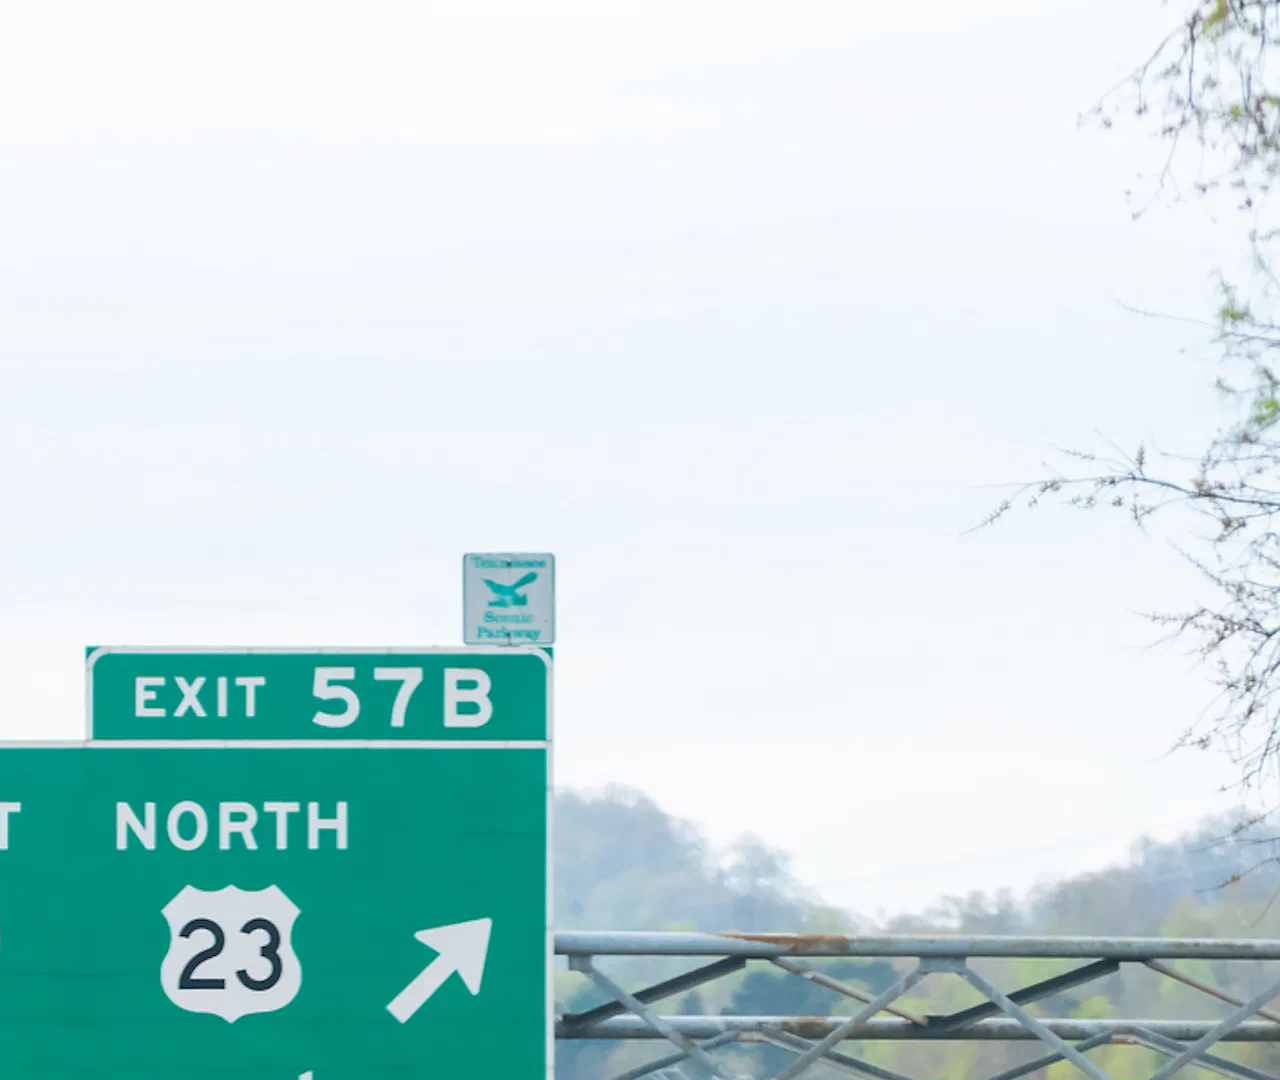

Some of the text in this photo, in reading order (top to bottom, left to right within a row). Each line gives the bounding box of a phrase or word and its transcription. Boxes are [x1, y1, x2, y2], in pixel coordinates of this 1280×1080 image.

[135, 666, 493, 728] EXIT 57B
[116, 800, 348, 851] NORTH
[178, 917, 283, 992] 23
